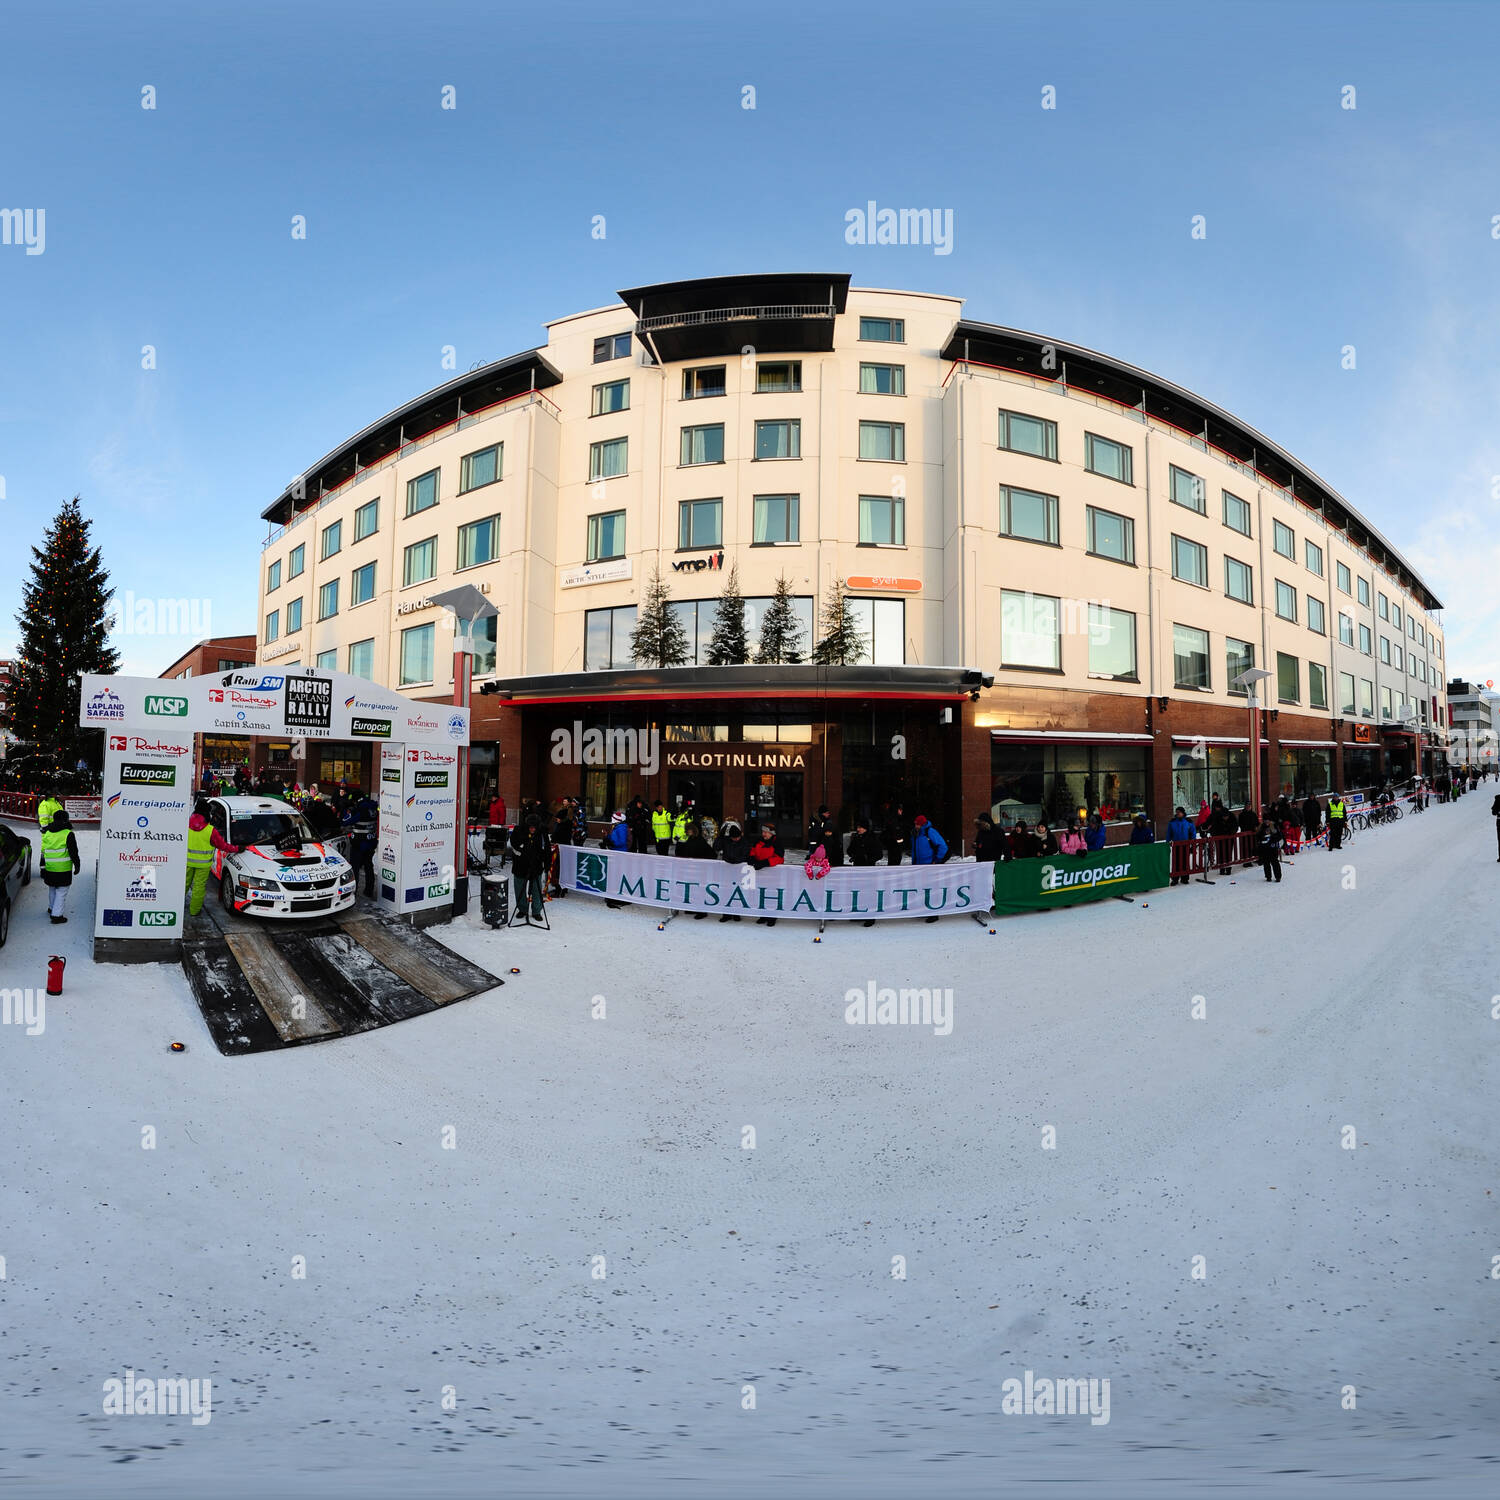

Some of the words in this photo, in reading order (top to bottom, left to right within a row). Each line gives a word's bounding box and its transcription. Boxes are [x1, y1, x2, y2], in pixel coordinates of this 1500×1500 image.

[672, 560, 707, 572] vmp
[233, 675, 258, 686] Ralli
[262, 677, 283, 688] SM
[289, 679, 330, 694] ARCTIC
[289, 693, 330, 703] LAPLAND
[87, 702, 125, 711] LAPLAND
[147, 698, 186, 714] MSP
[288, 701, 330, 717] RALLY
[355, 701, 399, 711] Energiapolar
[87, 709, 125, 718] SAFARIS
[214, 719, 240, 729] Lapin
[242, 721, 271, 730] Kansa
[288, 717, 328, 725] arcticrally.fi
[353, 720, 390, 734] Europcar
[407, 717, 439, 729] Rovaniemi
[129, 737, 189, 757] Rantasipi
[667, 753, 805, 768] KALOTINLINNA
[122, 766, 174, 782] Europcar
[416, 773, 447, 785] Europcar
[121, 799, 186, 809] Energiapolar
[415, 798, 454, 806] Energiapolar
[406, 824, 428, 833] Lapin
[429, 822, 453, 830] Kansa
[106, 828, 140, 840] Lapin
[143, 830, 183, 842] Kansa
[119, 852, 168, 863] Rovaniemi
[276, 870, 339, 882] ValueFrame
[1049, 862, 1131, 890] Europcar
[429, 884, 449, 898] MSP
[618, 874, 971, 913] METSÄHALLITUS
[142, 912, 174, 925] MSP
